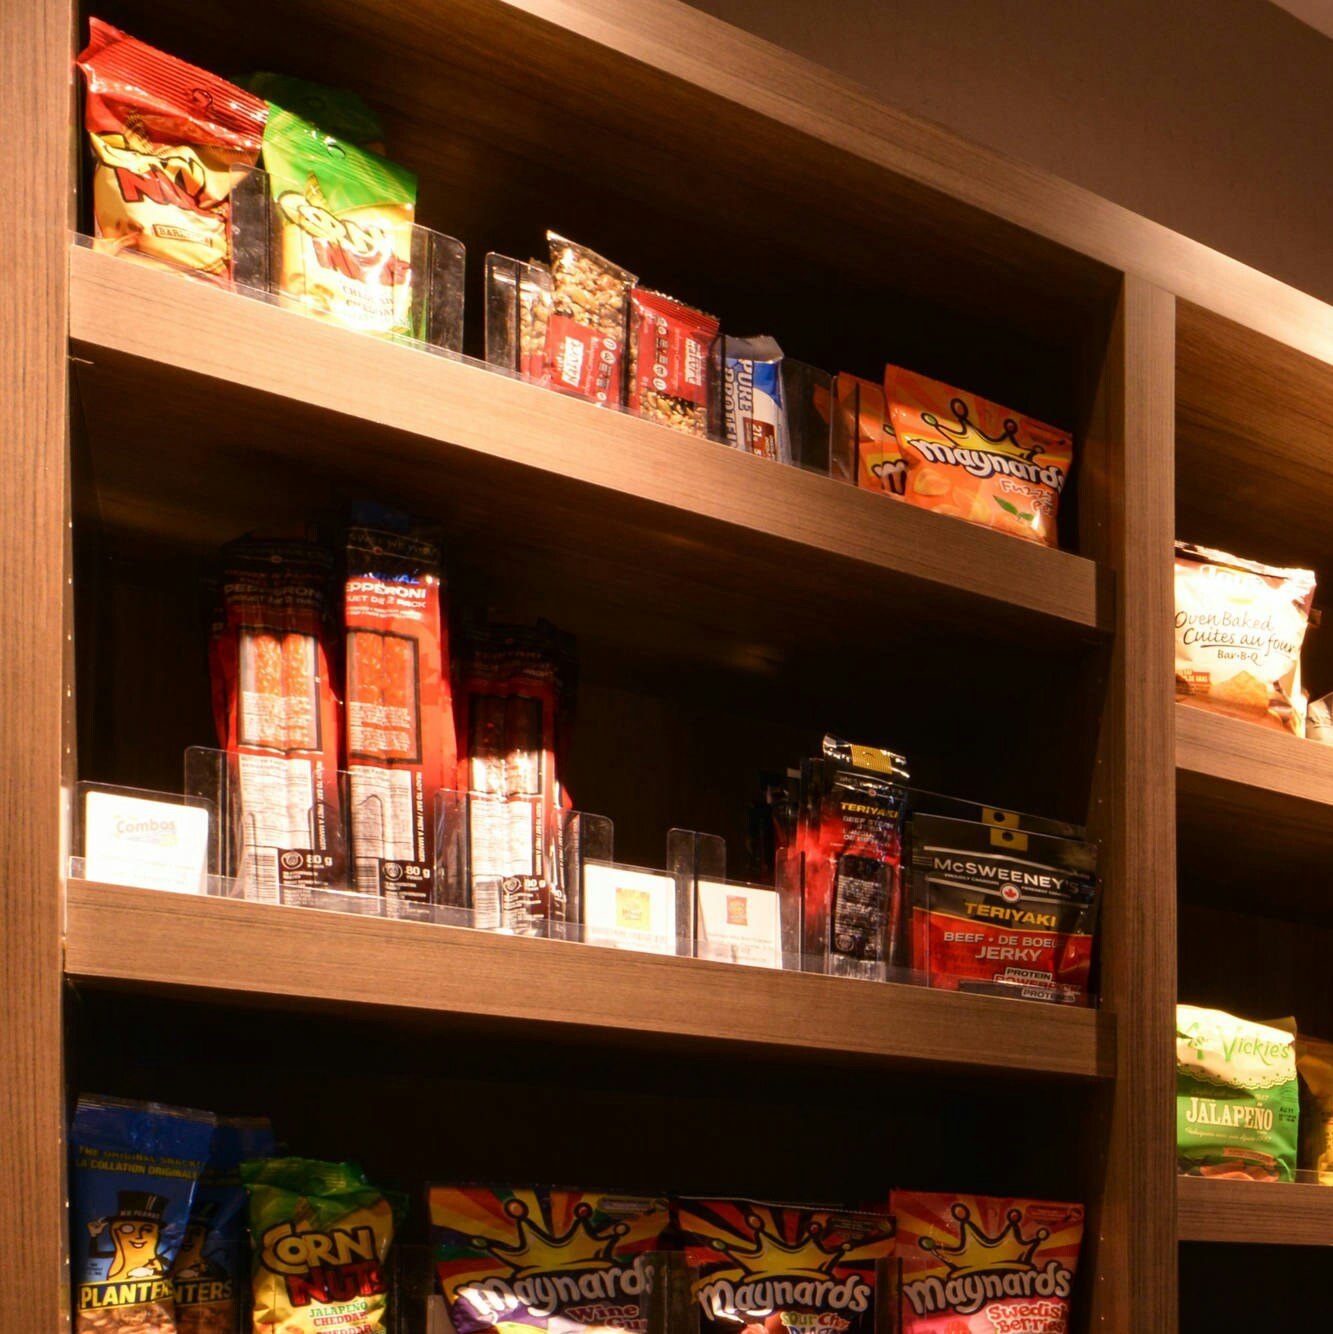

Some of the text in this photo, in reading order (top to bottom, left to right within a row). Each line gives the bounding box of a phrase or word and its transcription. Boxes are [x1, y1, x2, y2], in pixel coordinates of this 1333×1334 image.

[737, 359, 753, 412] PURE
[1174, 610, 1273, 630] Oven Baked
[1183, 627, 1296, 656] Cuites au four
[841, 802, 898, 818] TERIYAKI
[116, 820, 177, 834] Combos
[406, 866, 420, 876] 80
[934, 857, 1080, 893] McSWEENEY'S
[965, 902, 1057, 927] TERIYAKI
[944, 932, 1056, 949] BEEF DE BOE
[975, 946, 1043, 962] JERKY
[1006, 967, 1051, 981] PROTEIN
[1220, 1030, 1290, 1065] Vickie's
[1187, 1096, 1274, 1131] JALAPEÑO
[90, 1159, 146, 1175] COLLATION
[262, 1223, 374, 1275] CORN
[174, 1280, 233, 1304] NTERS
[287, 1264, 389, 1307] NUTS
[312, 1312, 368, 1327] CHEDDAR
[565, 1305, 640, 1323] Wine
